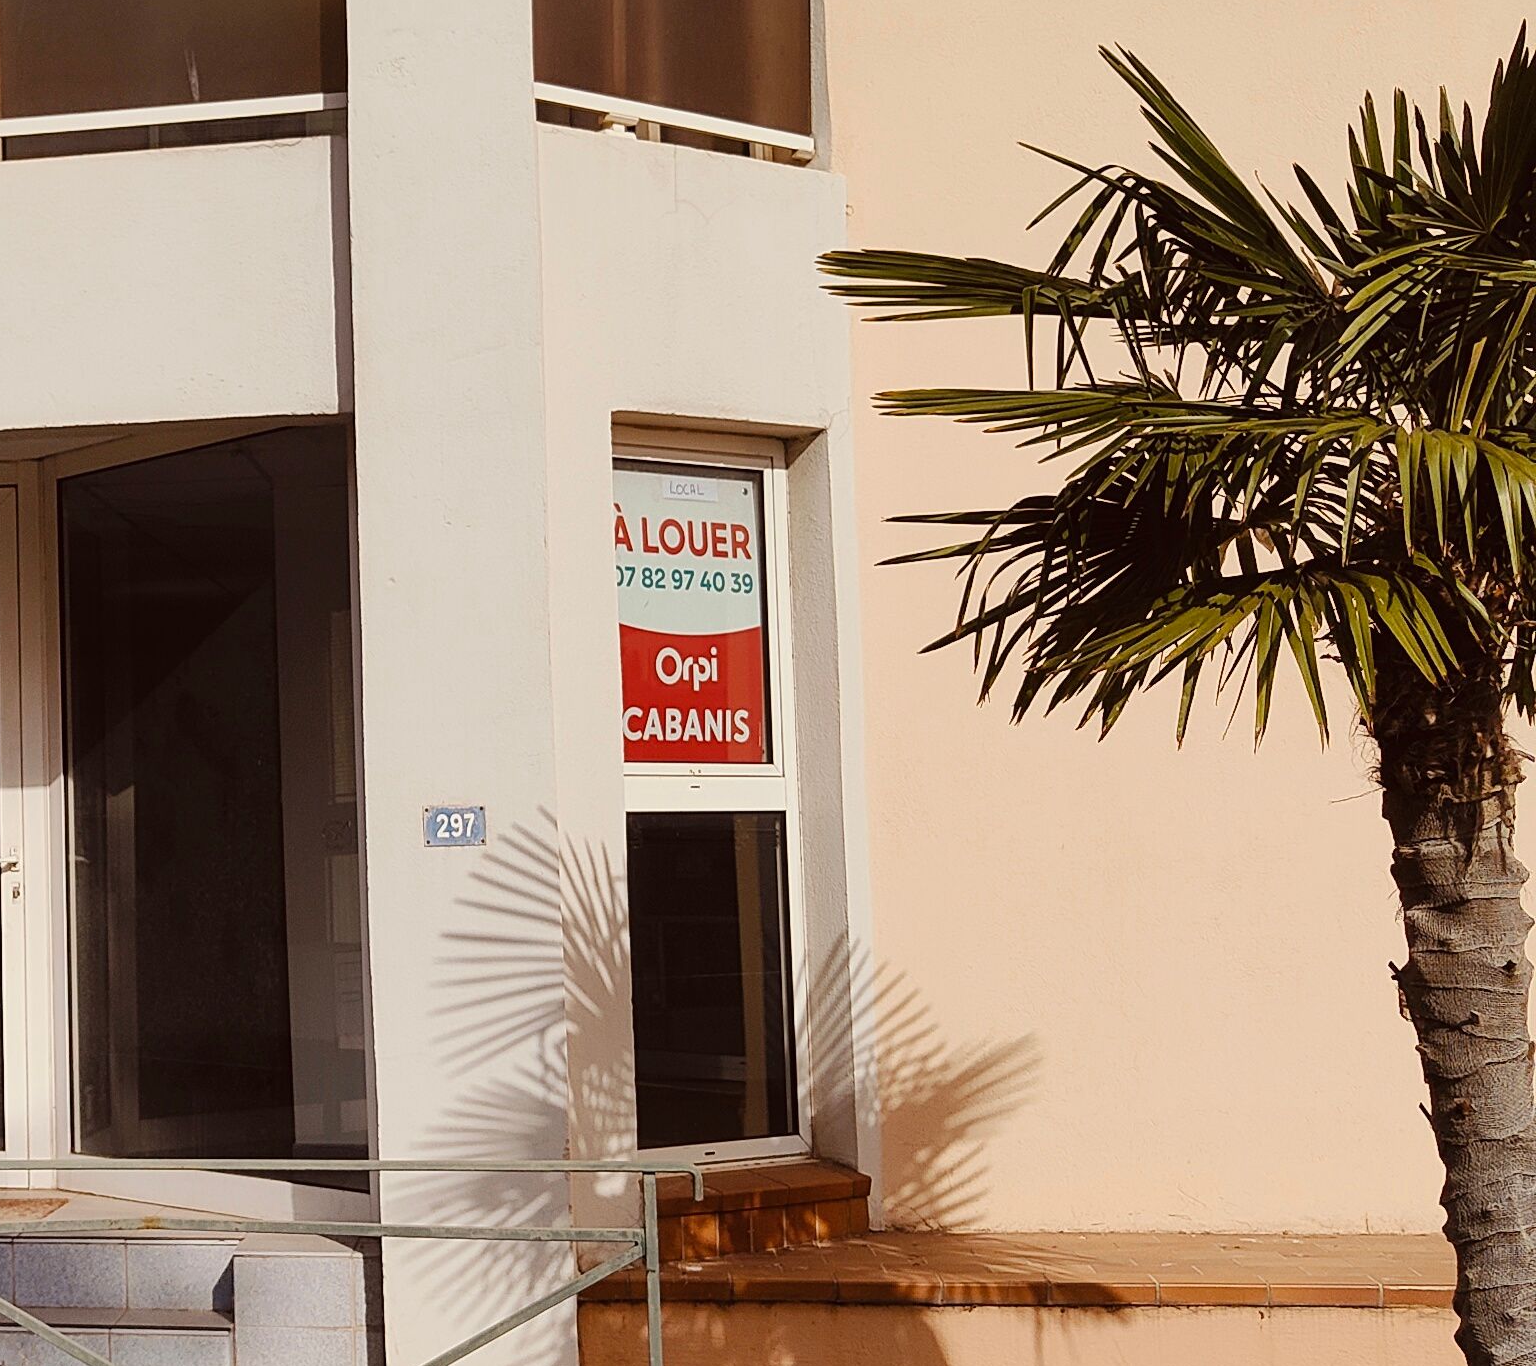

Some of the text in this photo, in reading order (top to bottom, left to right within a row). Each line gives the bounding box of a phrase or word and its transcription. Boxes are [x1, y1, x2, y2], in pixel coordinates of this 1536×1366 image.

[669, 481, 704, 495] LOCAL
[614, 502, 752, 560] À LOUER
[642, 567, 666, 589] 82
[671, 569, 695, 591] 97
[700, 571, 725, 593] 40
[730, 573, 754, 595] 39
[655, 646, 718, 691] Orpi
[623, 706, 750, 742] CABANIS
[436, 813, 475, 838] 297
